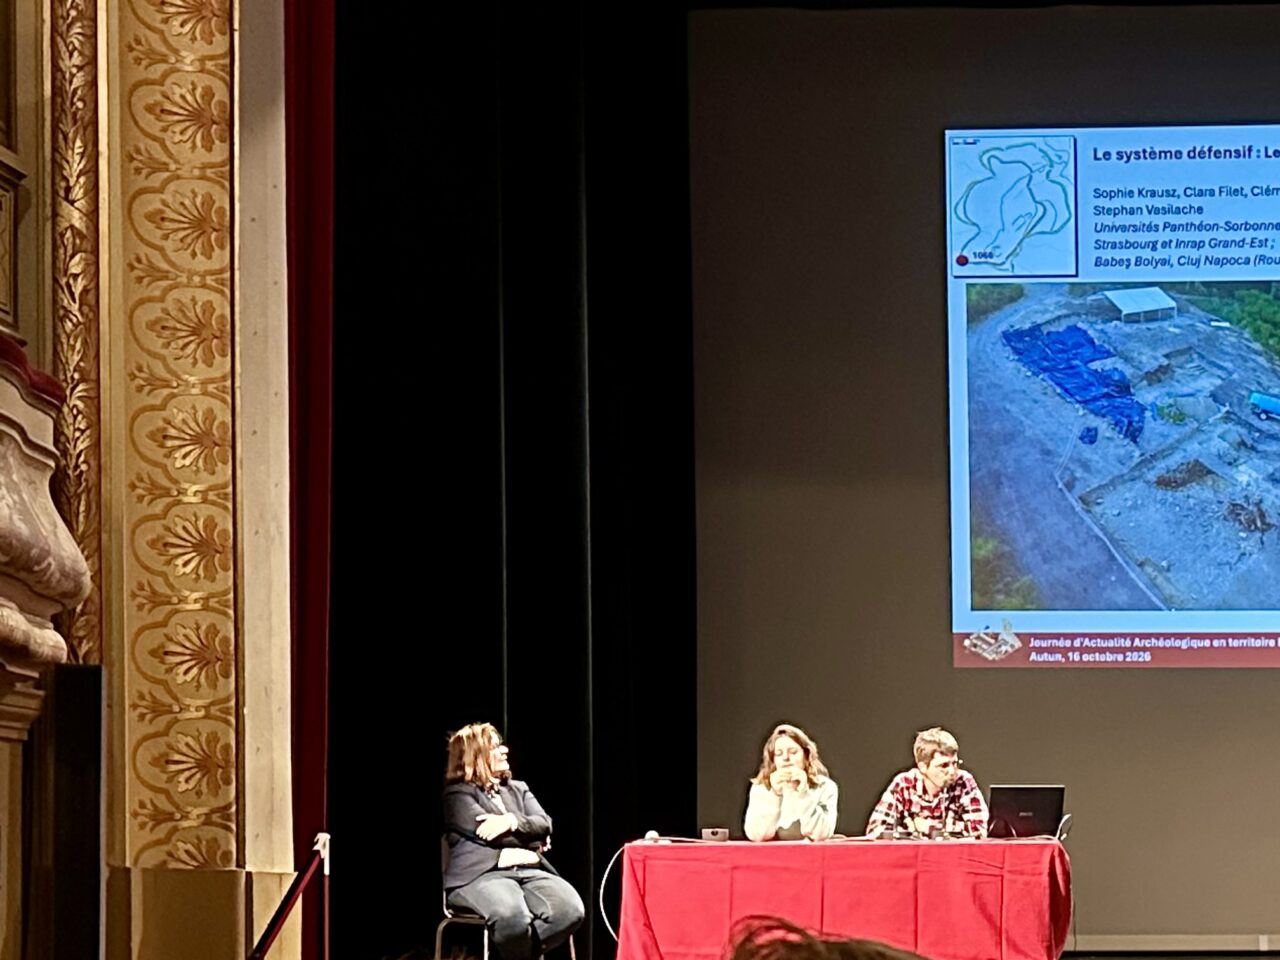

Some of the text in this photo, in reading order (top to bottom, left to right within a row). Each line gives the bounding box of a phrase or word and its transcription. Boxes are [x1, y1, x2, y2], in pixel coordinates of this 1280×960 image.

[1093, 147, 1111, 161] Le
[1116, 146, 1183, 164] système
[1187, 144, 1253, 160] défensif
[1093, 187, 1135, 202] Sophie
[1138, 187, 1181, 200] Krausz,
[1183, 186, 1215, 198] Clara
[1219, 185, 1248, 199] Filet,
[1093, 203, 1204, 218] Stephan Vasilache
[1094, 220, 1159, 234] Universités
[1094, 238, 1158, 252] Strasbourg
[1161, 239, 1172, 250] et
[1175, 238, 1205, 252] Inrap
[1208, 237, 1269, 250] Grand-Est
[1134, 255, 1174, 269] Bolyai,
[1177, 254, 1202, 269] Cluj
[1204, 254, 1250, 268] Napoca
[1029, 637, 1071, 648] Journée
[1073, 637, 1131, 648] d'Actualité
[1133, 637, 1211, 650] Archéologique
[1212, 638, 1226, 648] en
[1228, 637, 1275, 648] territoire
[1029, 651, 1066, 663] Autun,
[1068, 651, 1080, 662] 16
[1082, 651, 1124, 662] octobre
